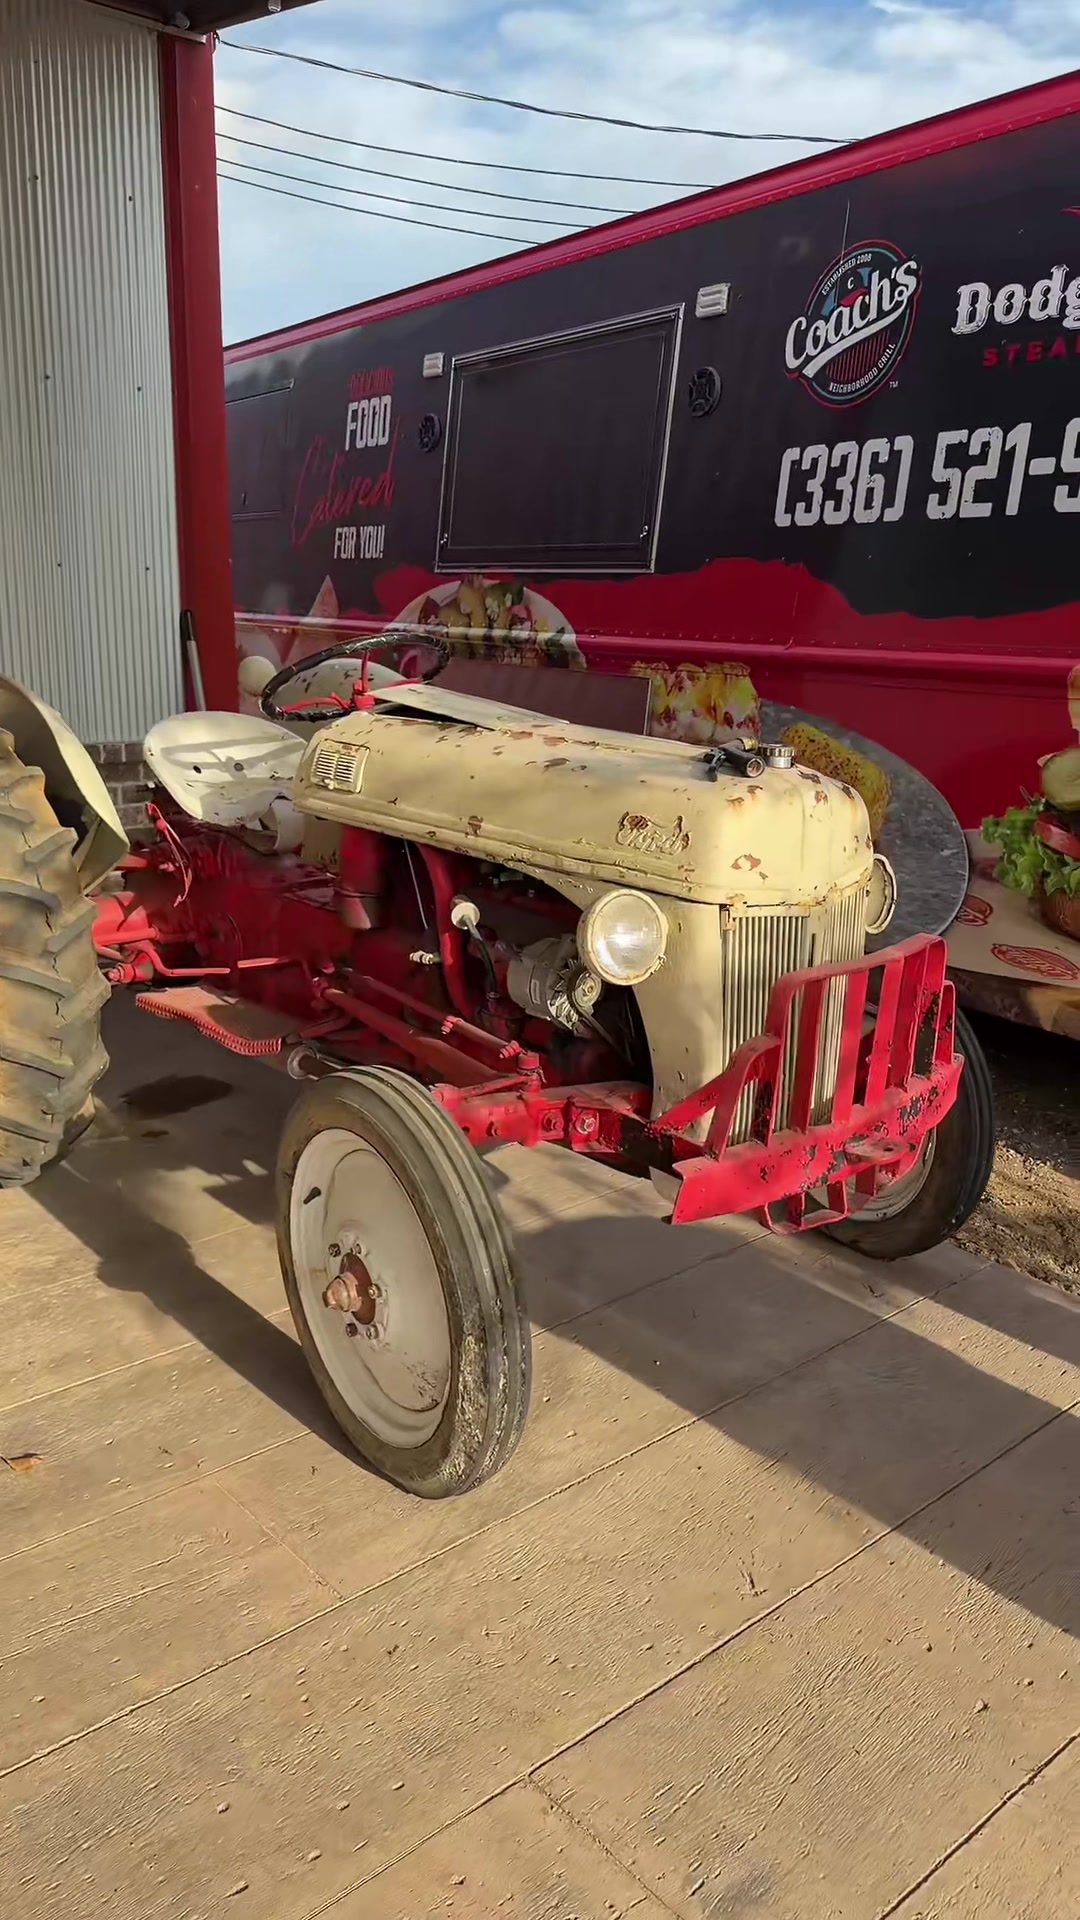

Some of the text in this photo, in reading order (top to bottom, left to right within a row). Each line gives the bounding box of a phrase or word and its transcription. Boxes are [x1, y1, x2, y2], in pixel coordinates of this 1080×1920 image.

[821, 257, 856, 296] ESTABLISHED
[785, 260, 918, 369] Coach's
[829, 343, 896, 393] NEIGHBORHOOD GRILL
[983, 335, 1080, 369] STEA
[345, 395, 392, 451] FOOD
[334, 524, 385, 560] FOR YOU!
